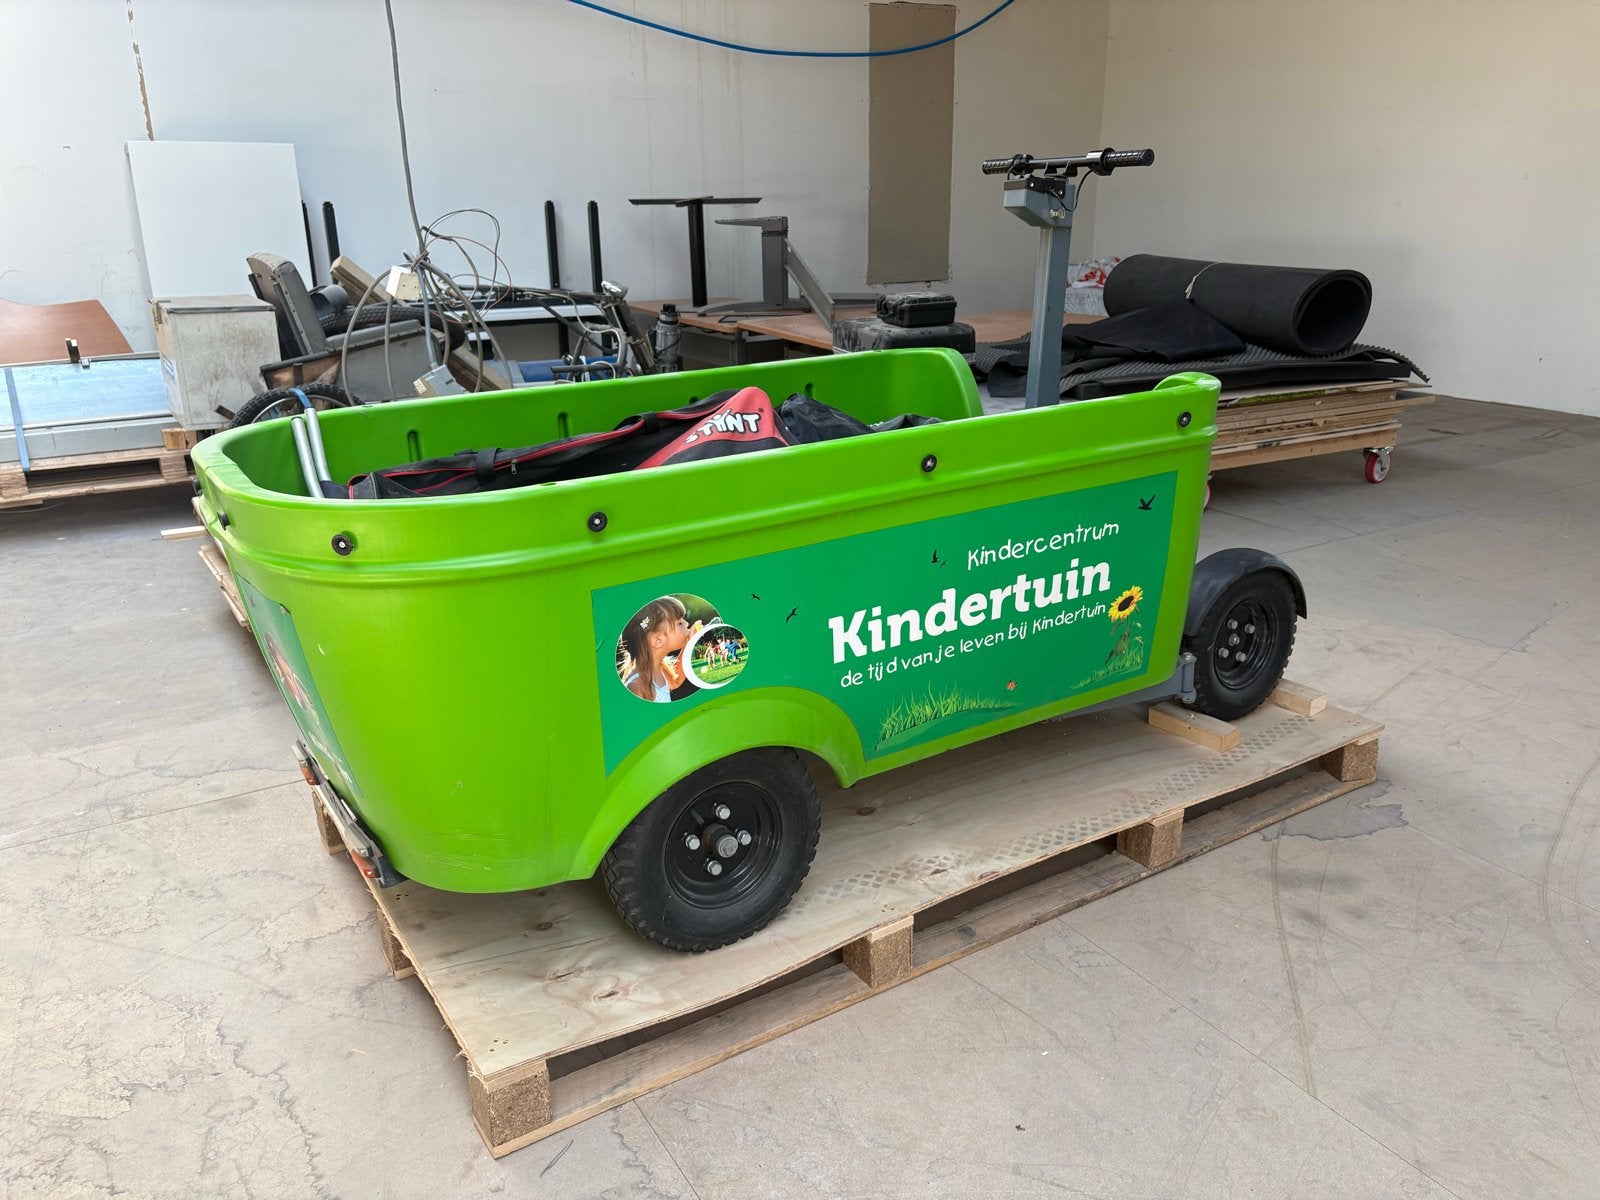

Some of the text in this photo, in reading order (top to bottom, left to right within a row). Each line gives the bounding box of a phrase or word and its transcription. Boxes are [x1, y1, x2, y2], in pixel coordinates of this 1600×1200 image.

[967, 521, 1119, 571] Kindercentrum
[828, 557, 1111, 664] Kindertuin
[840, 604, 1106, 688] de tijd van je leven bij Kindertuin
